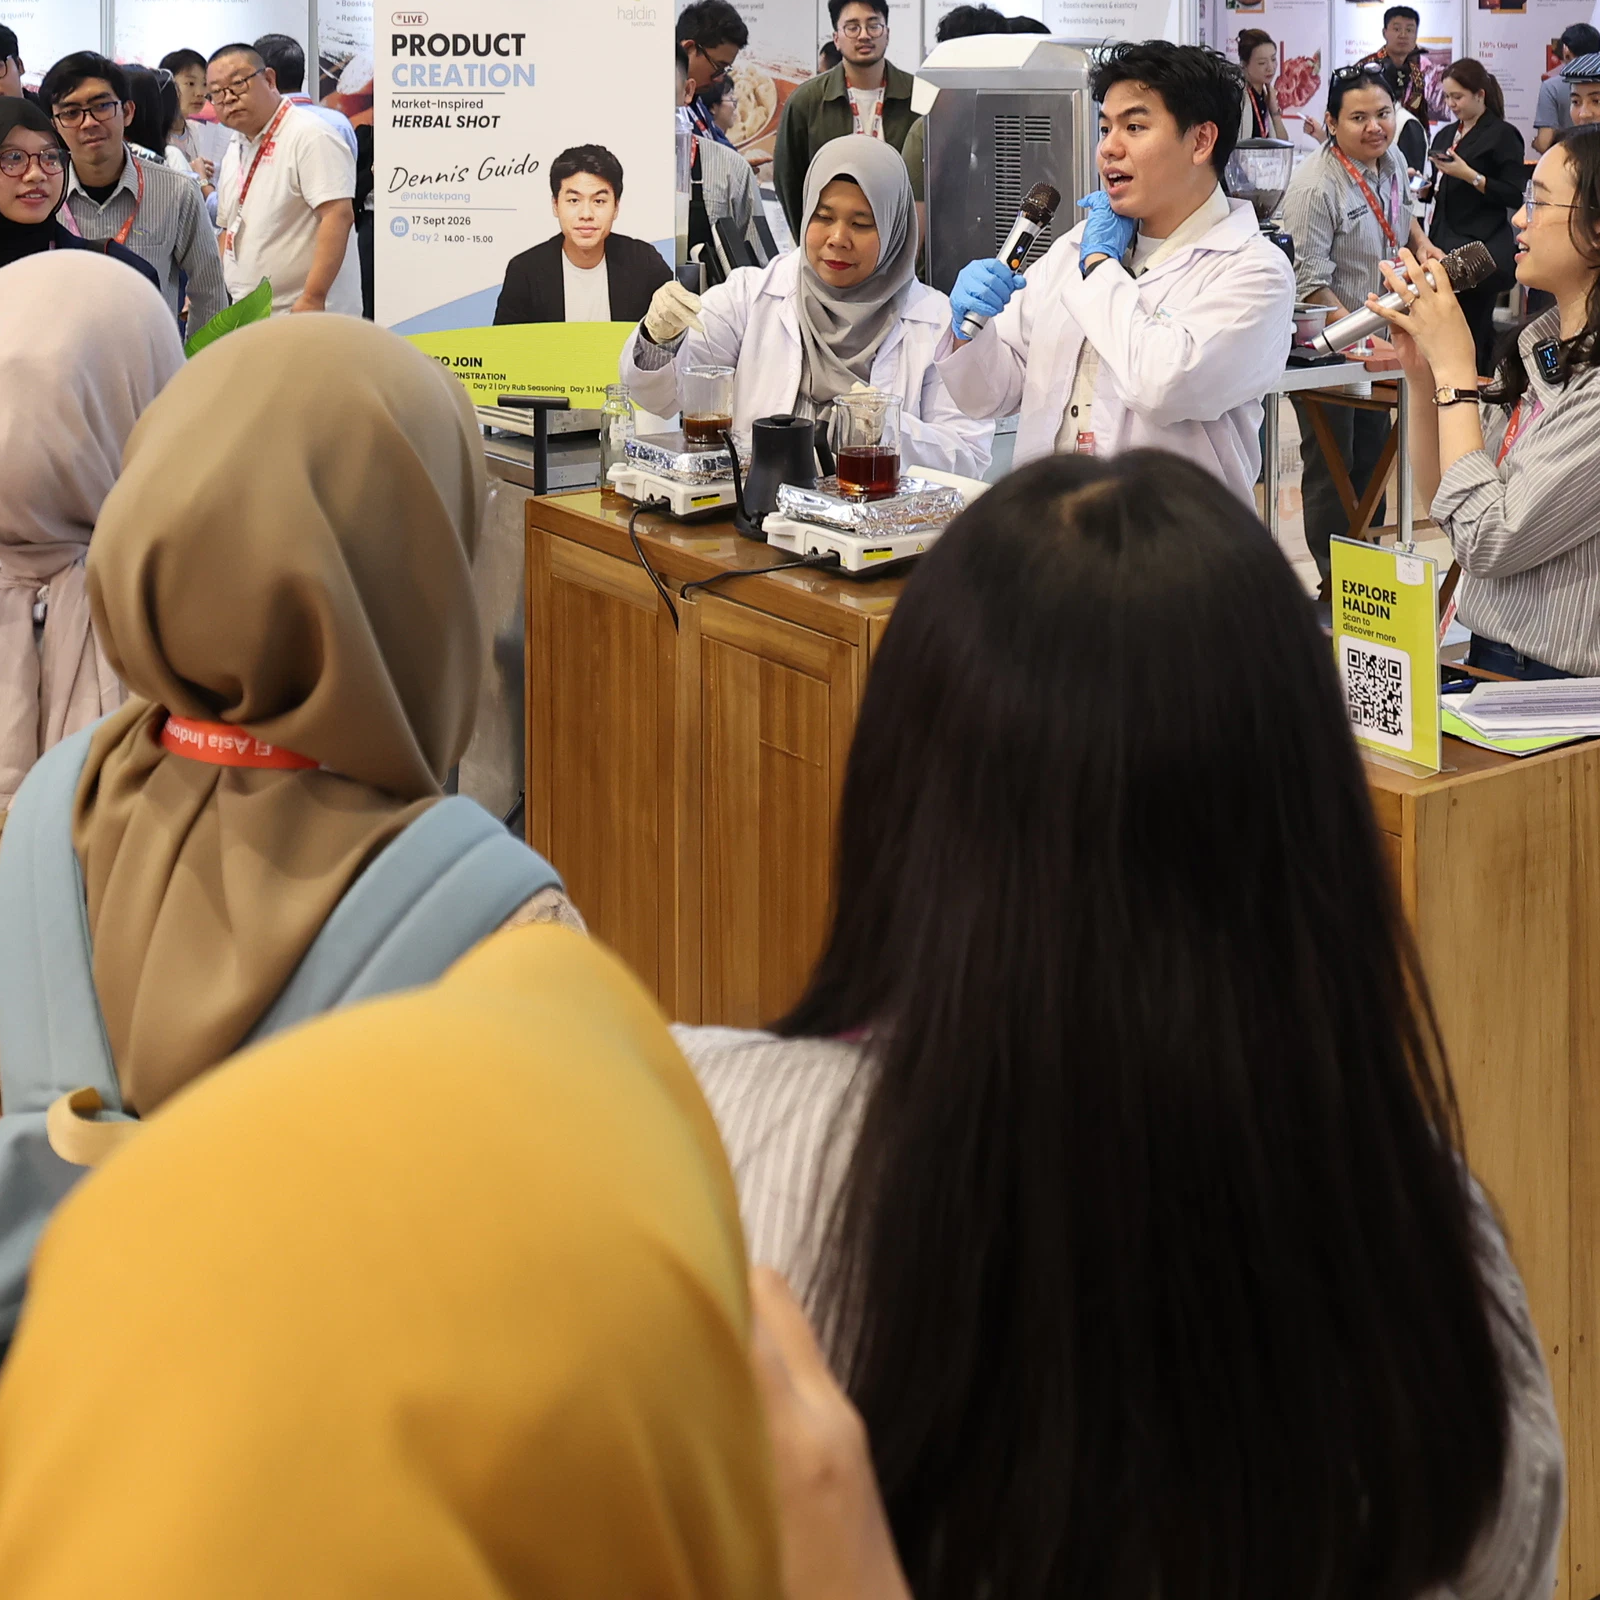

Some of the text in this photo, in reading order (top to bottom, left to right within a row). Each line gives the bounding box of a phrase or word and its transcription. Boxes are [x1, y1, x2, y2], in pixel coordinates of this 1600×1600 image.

[341, 0, 369, 8] Boosts
[1114, 1, 1137, 10] elasticity
[7, 11, 35, 21] quality
[341, 14, 372, 22] Reduces
[617, 6, 656, 20] haldin
[403, 15, 423, 24] LIVE
[392, 33, 526, 57] PRODUCT
[392, 63, 535, 87] CREATION
[392, 99, 484, 111] Market-Inspired
[392, 115, 501, 128] HERBAL SHOT
[388, 154, 539, 193] Dennis Guido
[400, 191, 470, 204] @naktekpang
[412, 215, 471, 227] 17 Sept 2026
[412, 232, 440, 245] Day 2
[444, 235, 493, 243] 14.00 15.00
[453, 356, 483, 367] JOIN
[453, 371, 506, 381] ONSTRATION
[473, 383, 566, 394] Day Dry Rub Seasoning
[570, 386, 584, 395] Day
[1342, 579, 1397, 605] EXPLORE
[1343, 596, 1390, 620] HALDIN
[1343, 612, 1371, 626] Scan to
[1343, 622, 1397, 643] discover more
[208, 734, 273, 757] Fi Asia
